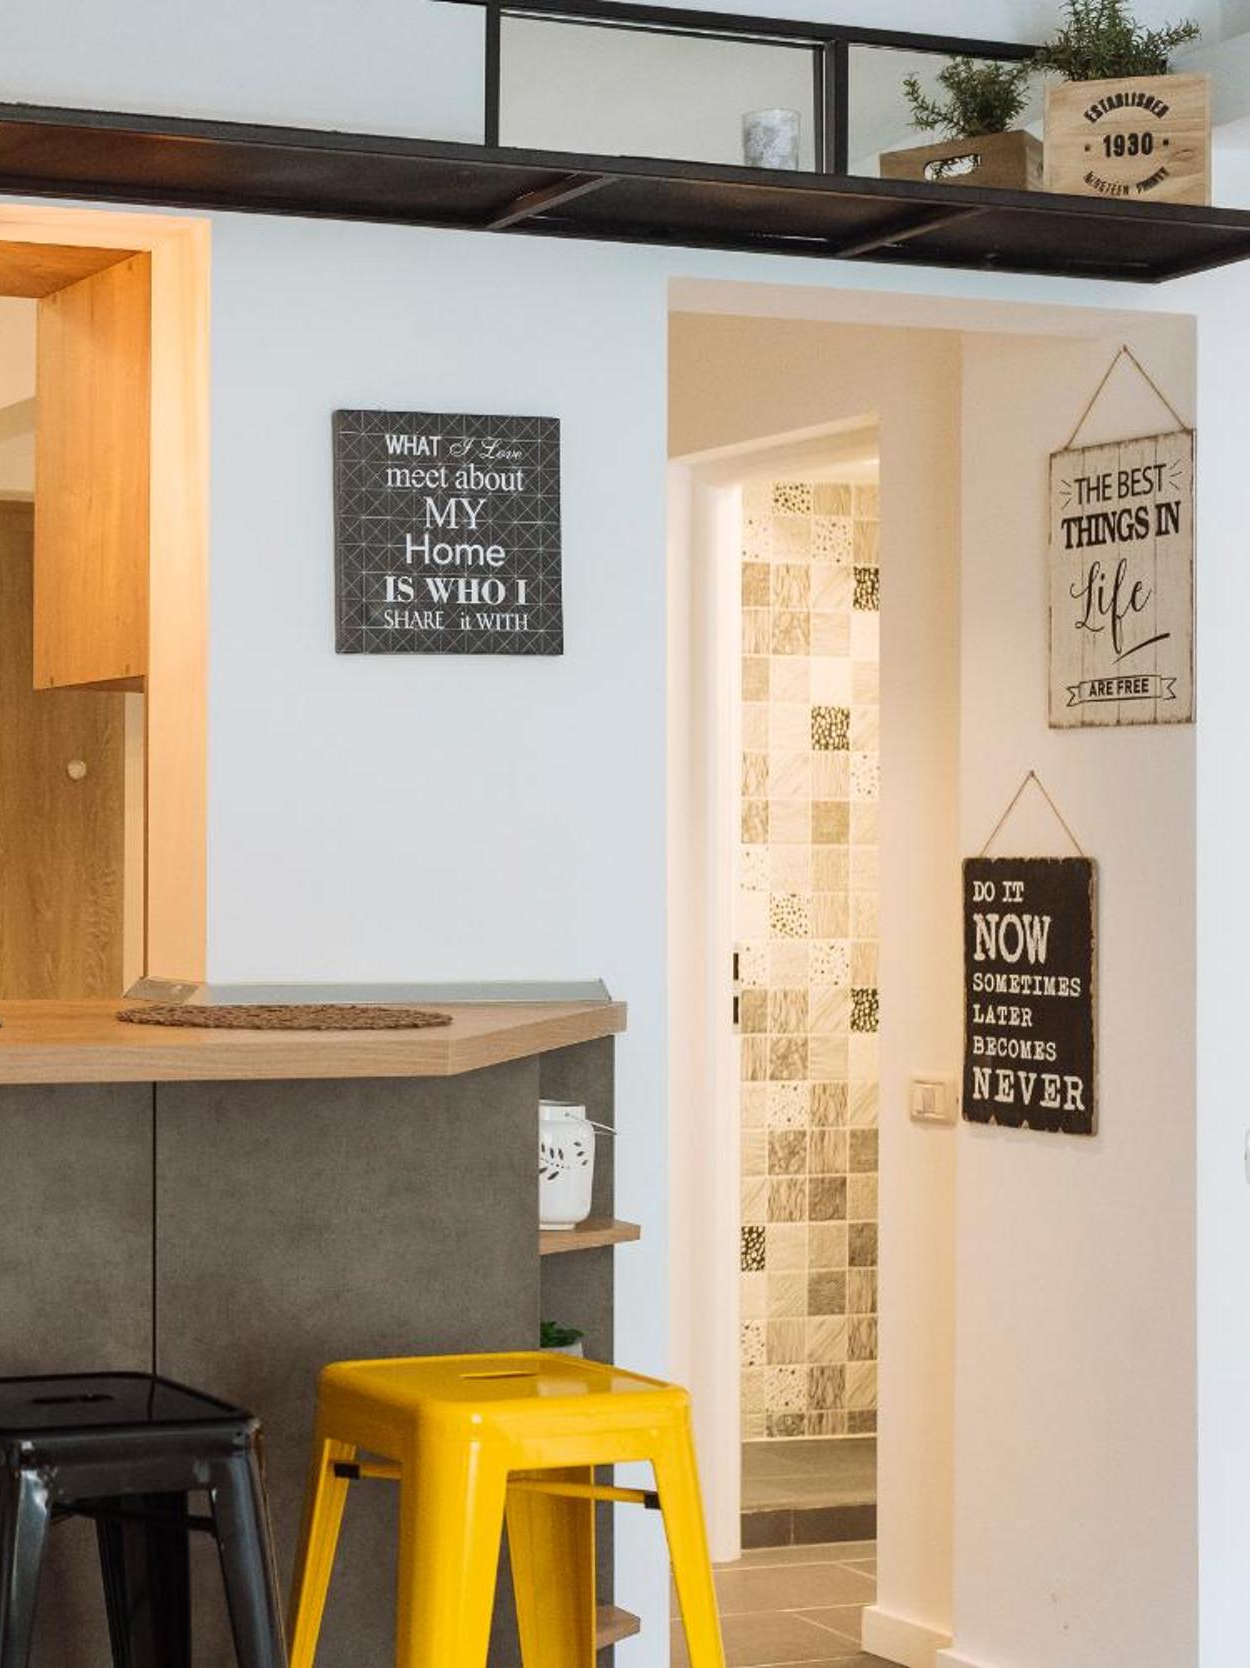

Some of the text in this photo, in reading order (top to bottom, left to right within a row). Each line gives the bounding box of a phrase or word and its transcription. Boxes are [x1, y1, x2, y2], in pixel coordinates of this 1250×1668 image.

[1103, 131, 1153, 157] 1930
[385, 434, 442, 456] WHAT
[480, 436, 523, 459] Love
[386, 463, 524, 491] meet about
[1074, 463, 1167, 505] THE BEST
[423, 496, 486, 529] MY
[1061, 500, 1181, 549] THINGS IN
[405, 533, 506, 567] Home
[383, 575, 528, 605] IS WHO I
[384, 610, 528, 630] SHARE it WITH
[1070, 558, 1152, 654] Life
[1088, 678, 1149, 696] ARE FREE
[973, 881, 1025, 902] DO IT
[973, 913, 1051, 964] NOW
[973, 973, 1081, 997] SOMETIMES
[973, 1004, 1033, 1027] LATER
[973, 1036, 1057, 1061] BECOMES
[973, 1067, 1085, 1111] NEVER
